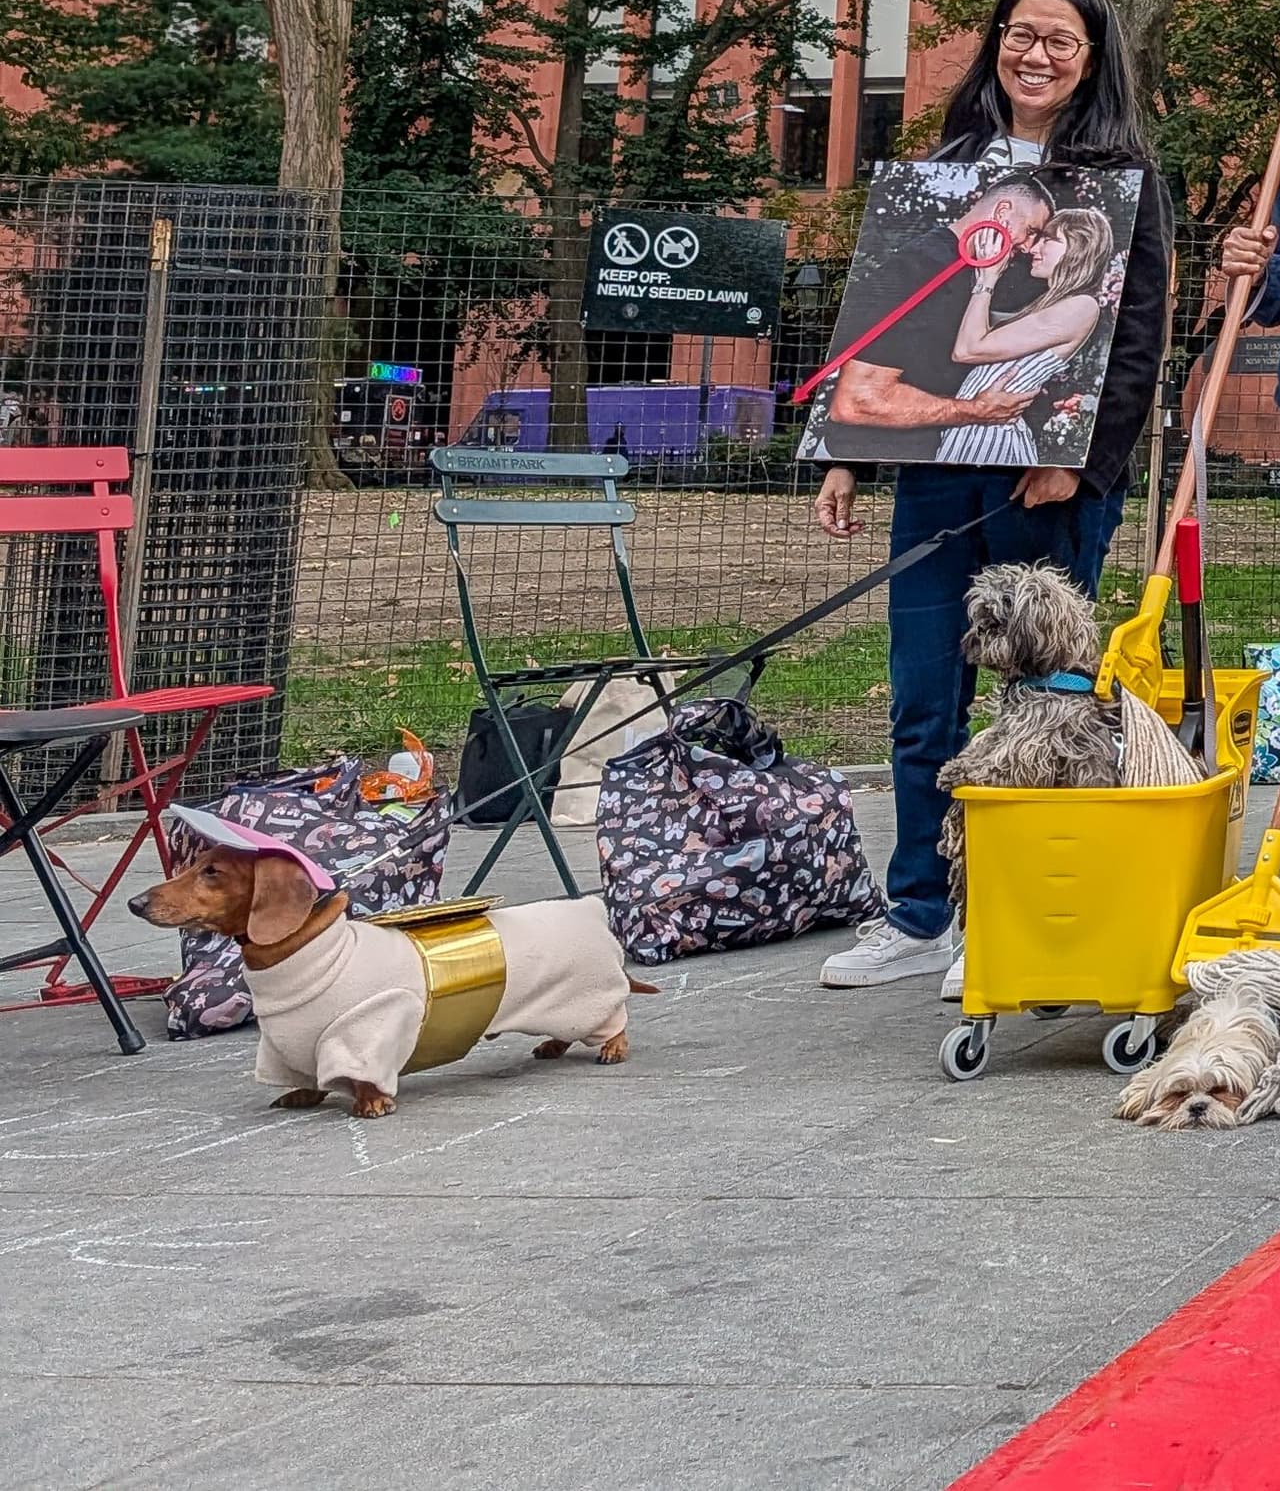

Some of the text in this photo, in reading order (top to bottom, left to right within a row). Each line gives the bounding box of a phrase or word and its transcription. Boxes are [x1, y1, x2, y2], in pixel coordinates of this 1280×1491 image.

[599, 268, 671, 285] KEEP OFF:
[597, 283, 749, 304] NEWLY SEEDED LAWN
[457, 456, 545, 470] BRYANT PARK
